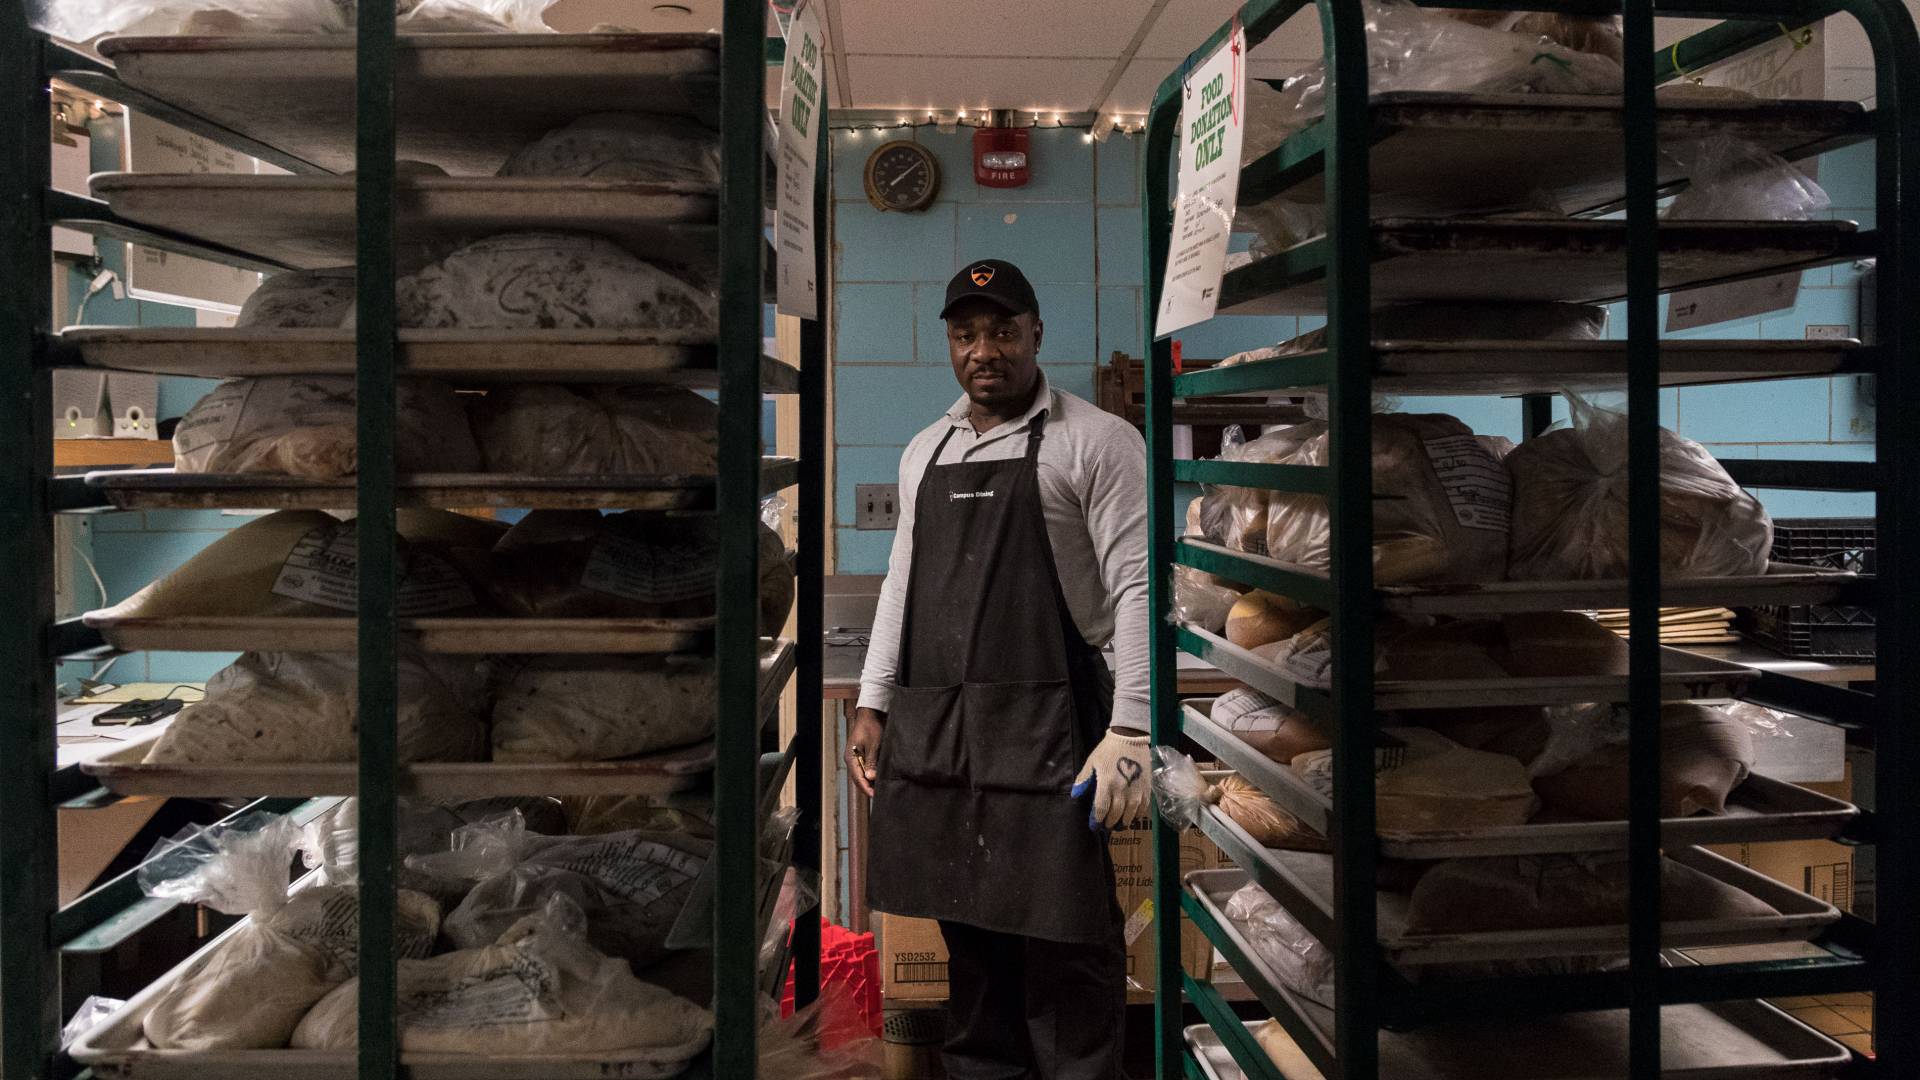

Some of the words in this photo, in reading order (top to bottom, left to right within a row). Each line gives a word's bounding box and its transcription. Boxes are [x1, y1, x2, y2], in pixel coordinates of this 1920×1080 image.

[1200, 72, 1223, 110] FOOD
[1191, 91, 1233, 145] DONATION
[1195, 125, 1226, 172] ONLY
[991, 172, 1016, 180] FIRE
[1110, 836, 1142, 846] tainers
[1111, 863, 1142, 873] Combo
[1117, 878, 1134, 887] 240
[895, 952, 936, 961] YSD2532
